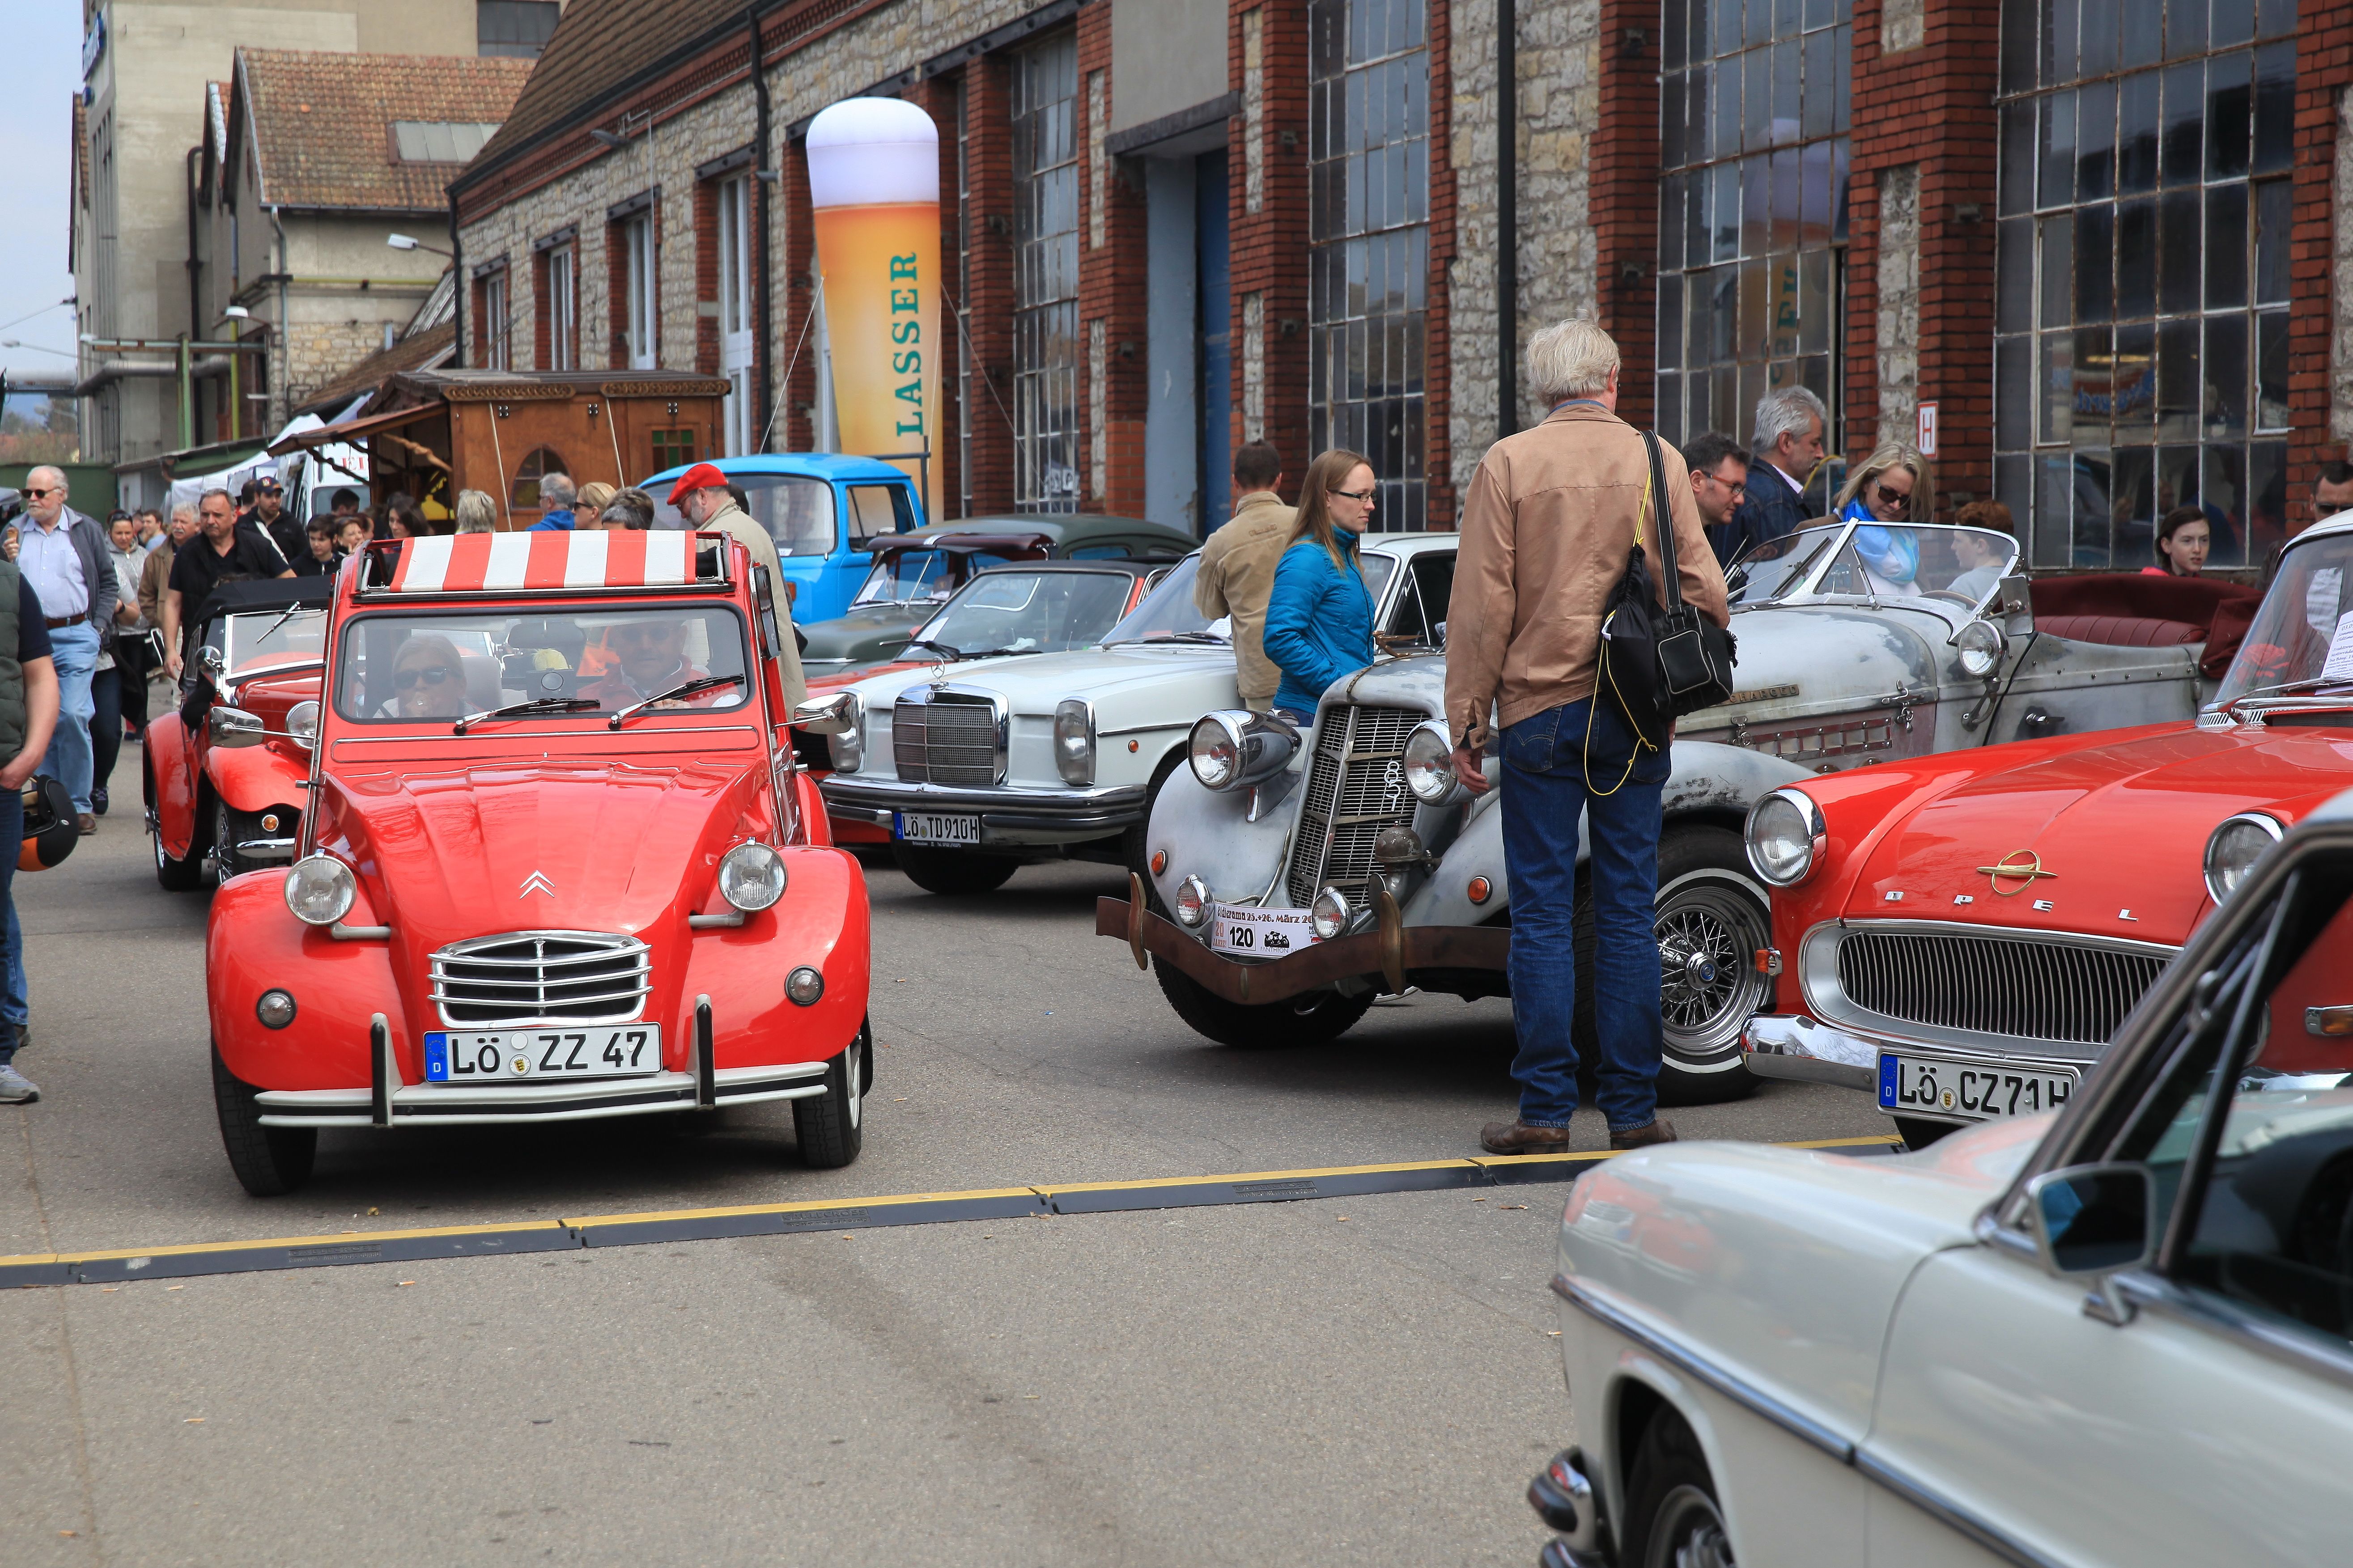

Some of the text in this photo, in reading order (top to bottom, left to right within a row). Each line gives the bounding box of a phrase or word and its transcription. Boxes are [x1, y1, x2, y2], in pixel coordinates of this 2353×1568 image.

[890, 252, 923, 436] LASSER
[1923, 413, 1932, 448] H
[903, 816, 918, 837] LÖ
[1885, 890, 2139, 922] OPEL
[1215, 921, 1224, 937] 20
[1276, 914, 1300, 923] März
[1230, 926, 1253, 948] 120
[452, 1036, 501, 1073] LÖ
[539, 1034, 588, 1070] ZZ
[603, 1031, 648, 1068] 47
[433, 1062, 442, 1072] D
[1885, 1086, 1892, 1097] D
[1899, 1062, 1937, 1105] LÖ
